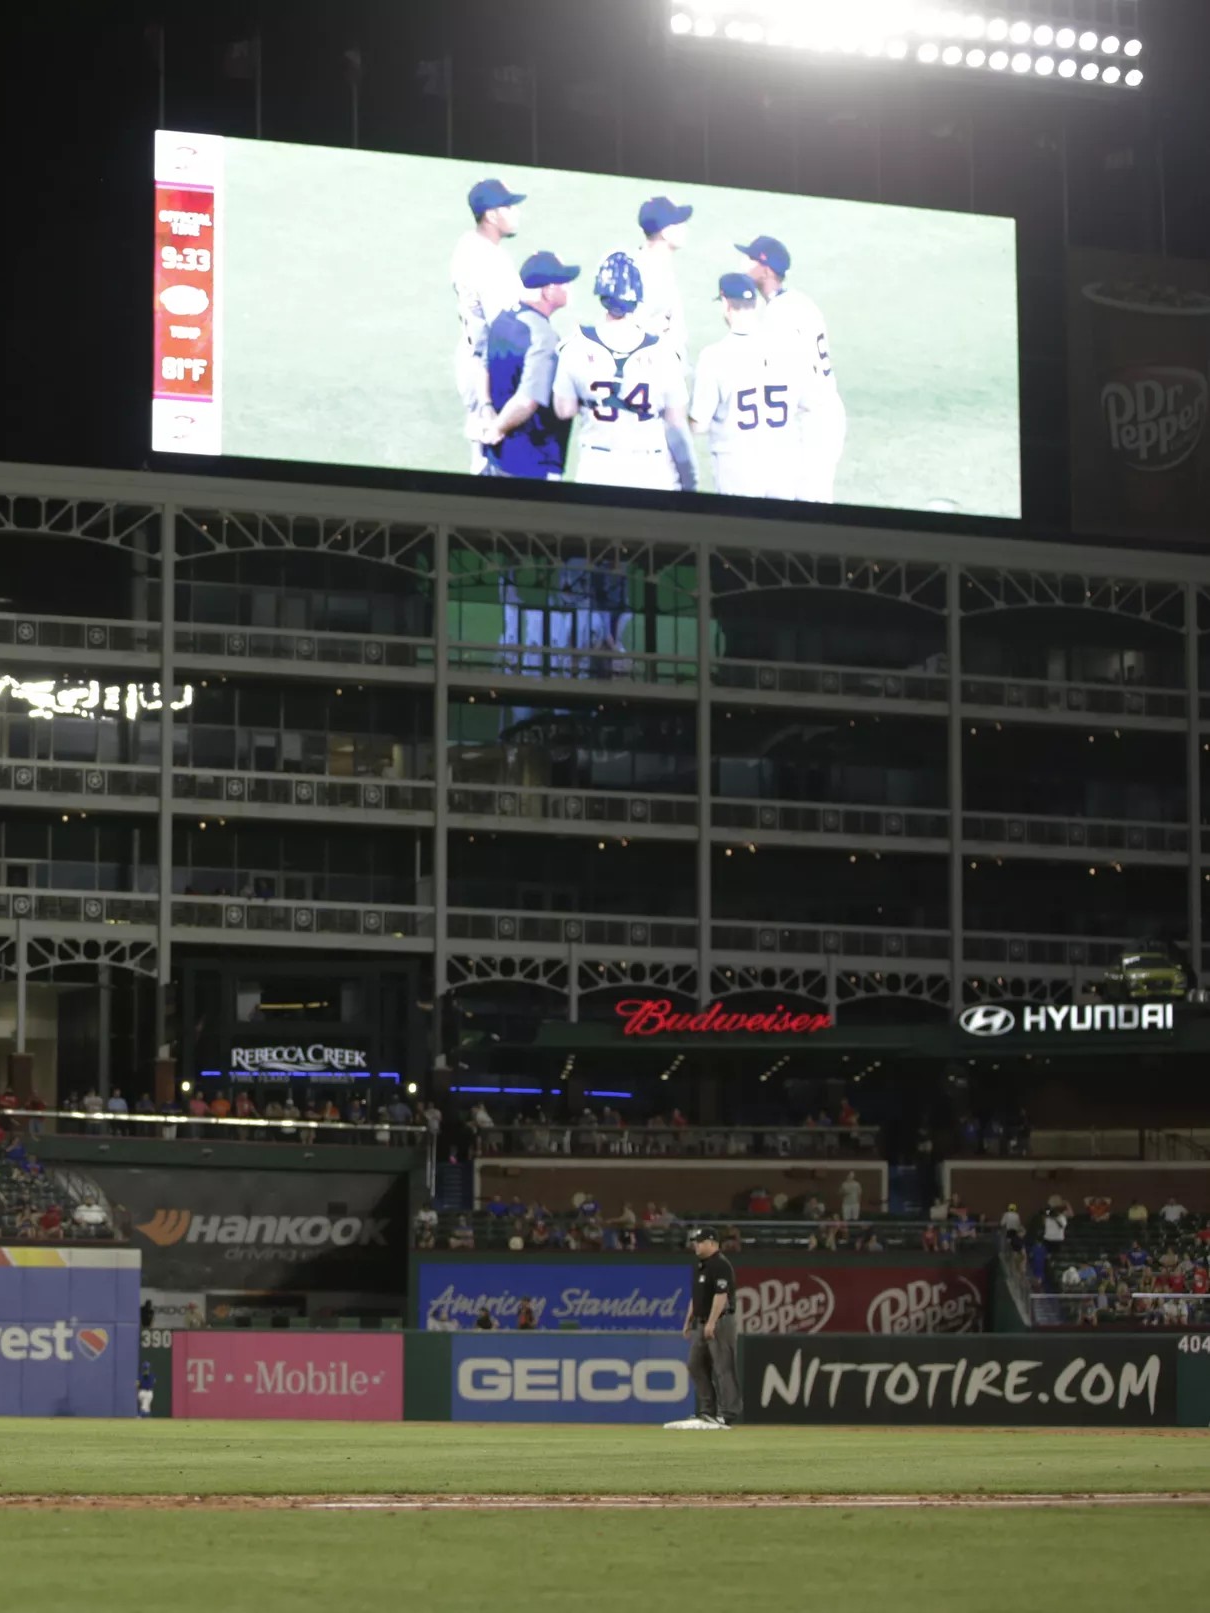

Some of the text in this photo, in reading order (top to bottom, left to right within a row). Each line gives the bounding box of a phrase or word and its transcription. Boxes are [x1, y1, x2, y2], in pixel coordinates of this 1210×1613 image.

[161, 246, 211, 271] 9:33
[590, 381, 652, 422] 34
[737, 385, 787, 430] 55
[1135, 379, 1183, 421] Dr
[1101, 382, 1201, 459] Pepper
[616, 1000, 834, 1035] Budweiser
[1024, 1003, 1174, 1032] HYUNDAI
[231, 1043, 367, 1071] REBECCA CREEK
[552, 1287, 683, 1318] Standard
[759, 1279, 800, 1312] Dr
[906, 1280, 947, 1312] Dr
[141, 1330, 172, 1348] 390
[457, 1358, 689, 1401] GEICO
[761, 1348, 1161, 1416] NITTOTIRE.COM
